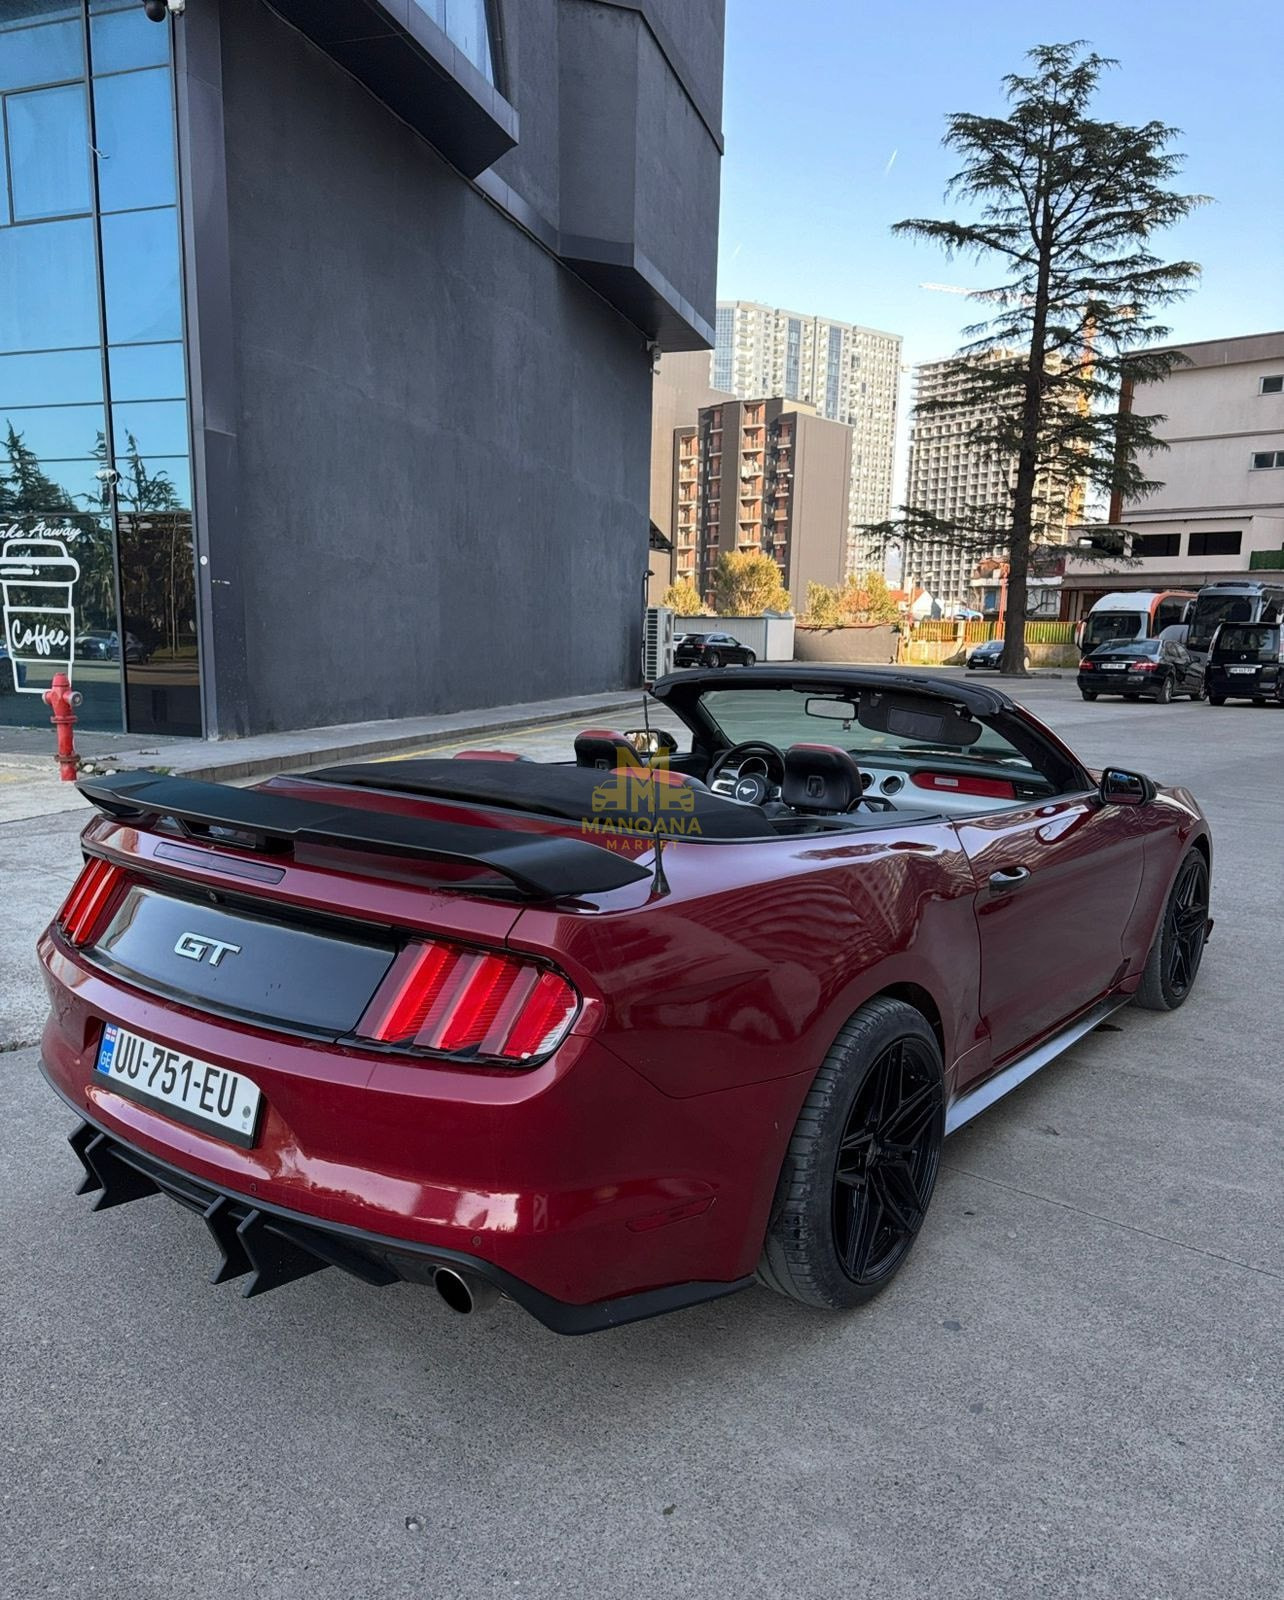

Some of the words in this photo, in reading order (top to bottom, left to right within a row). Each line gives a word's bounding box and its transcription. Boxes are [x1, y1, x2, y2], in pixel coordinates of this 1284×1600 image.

[28, 521, 82, 542] Aaway
[11, 619, 69, 655] Coffee
[174, 932, 242, 967] GT
[100, 1051, 112, 1068] GE
[114, 1033, 238, 1118] UU-751-EU
